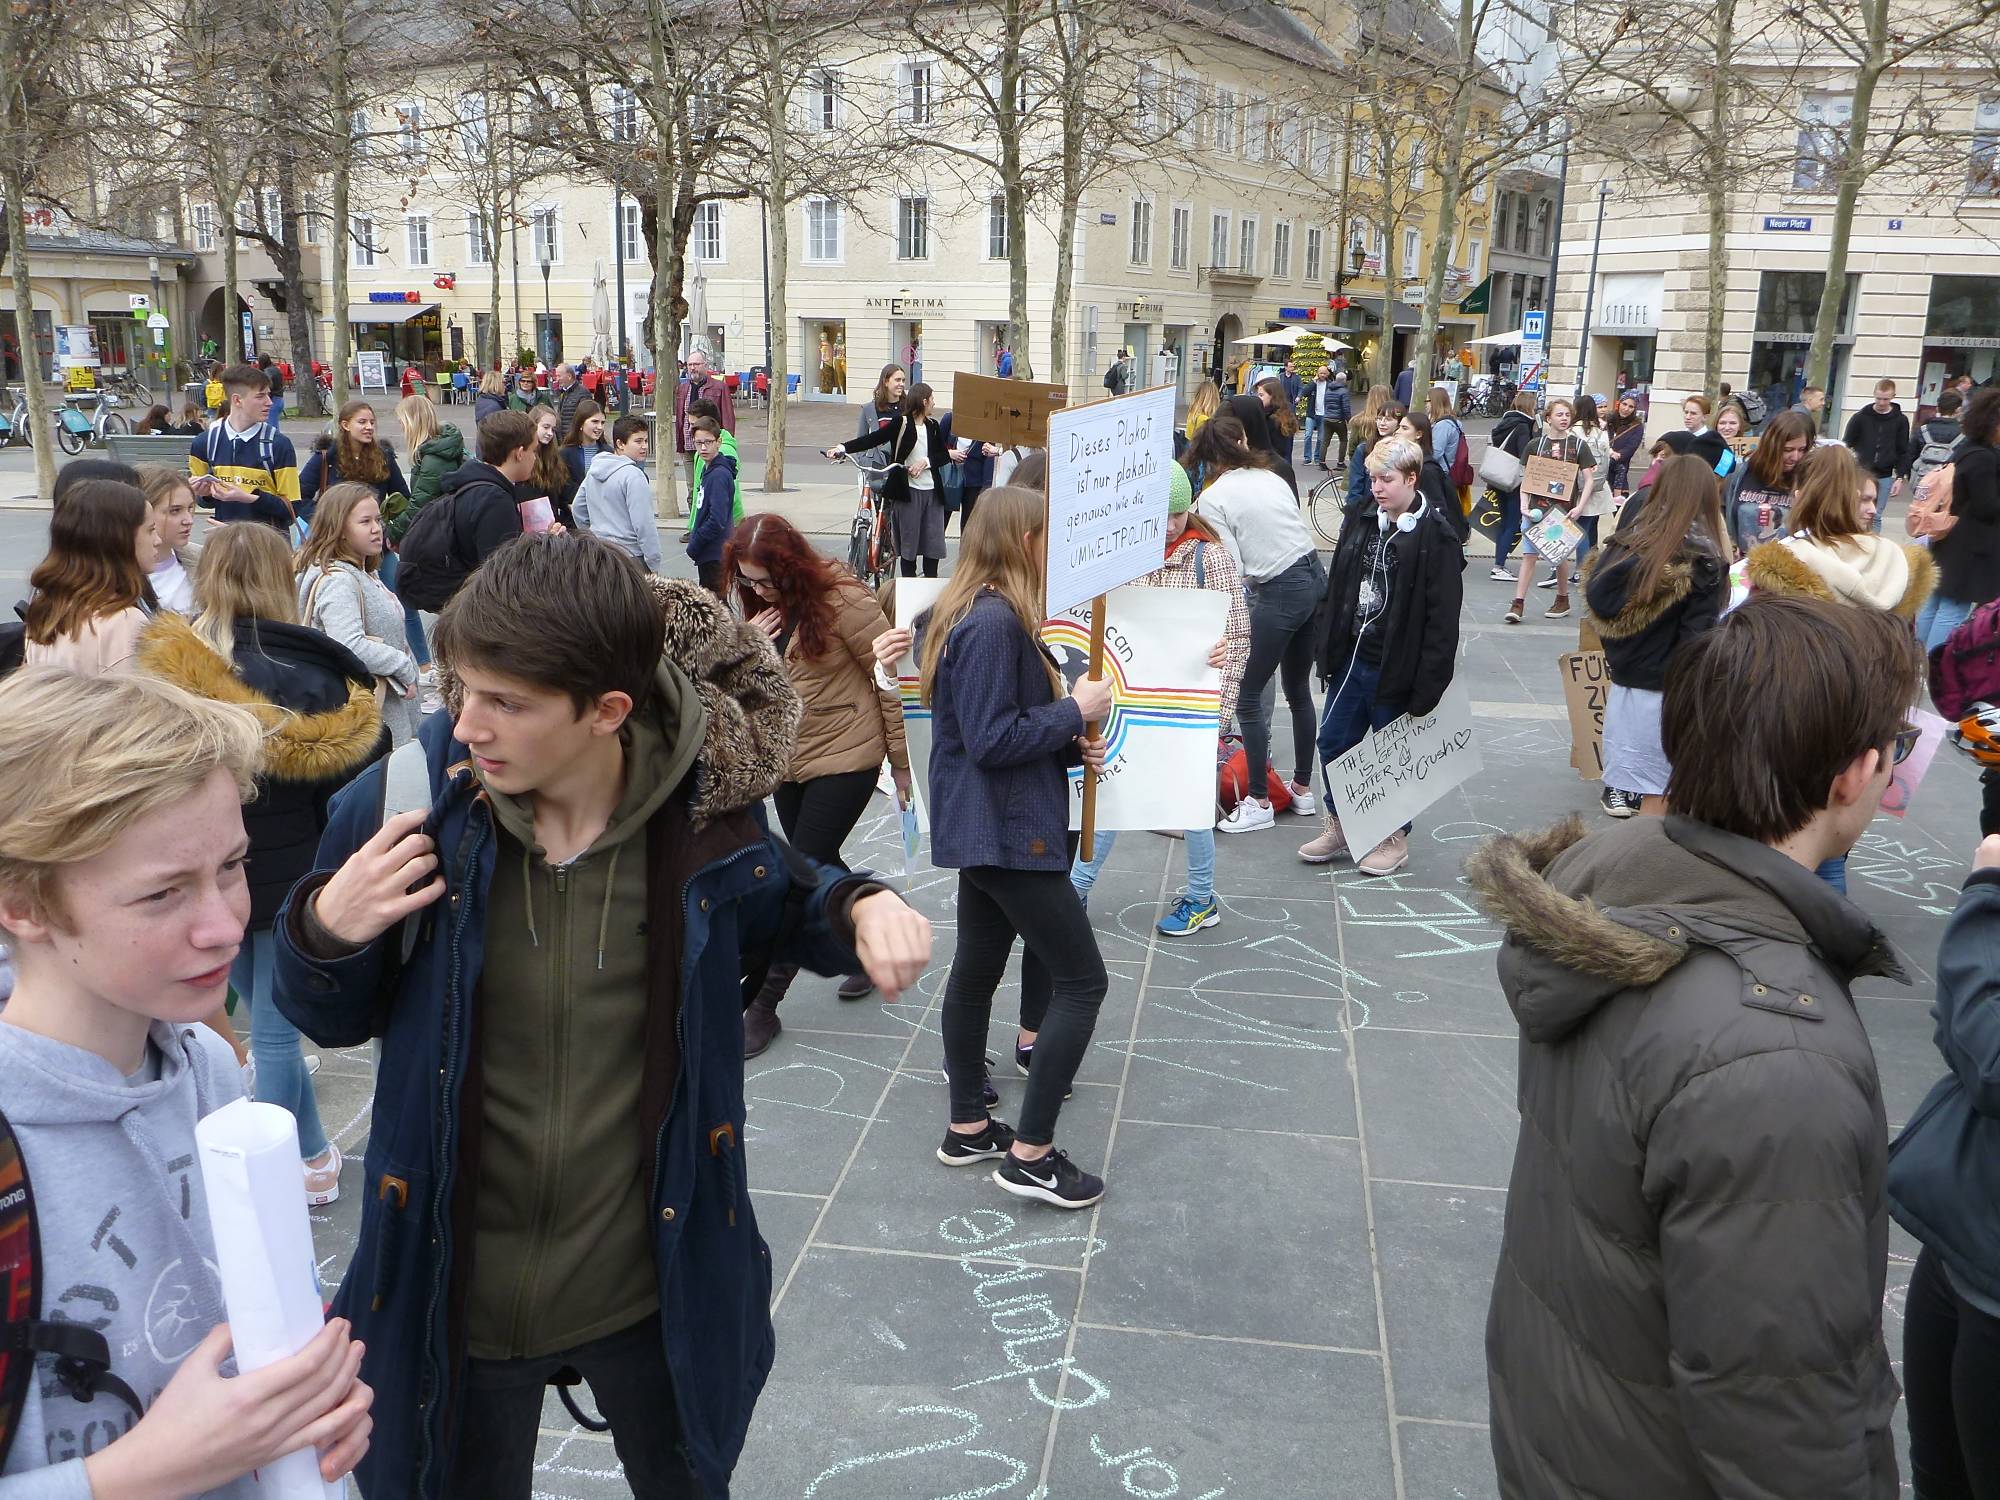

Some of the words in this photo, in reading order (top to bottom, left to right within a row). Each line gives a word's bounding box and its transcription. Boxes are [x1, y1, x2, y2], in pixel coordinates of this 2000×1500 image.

[1790, 219, 1807, 229] Platz
[1891, 220, 1898, 229] 5
[865, 298, 944, 315] ANTEPRIMA
[1117, 302, 1164, 320] ANTEPRIMA
[1604, 304, 1648, 325] STOFFE
[1070, 432, 1111, 464] Dieses
[1116, 413, 1154, 447] Plakat
[1077, 464, 1094, 495] ist
[1093, 477, 1111, 491] nur
[1114, 450, 1159, 493] plakativ
[1066, 503, 1112, 542] genauso
[1115, 496, 1130, 512] wie
[1132, 490, 1144, 506] die
[1070, 516, 1160, 568] UMWELTPOLITIK
[1068, 606, 1092, 624] we
[1105, 625, 1136, 664] can
[1336, 749, 1367, 775] THE
[1372, 713, 1414, 756] EARTH
[1359, 762, 1374, 777] IS
[1378, 716, 1437, 764] GETTING
[1075, 752, 1128, 799] panet
[1345, 765, 1394, 804] HOTTER
[1355, 787, 1386, 815] THAN
[1394, 764, 1414, 787] MY
[1416, 738, 1454, 780] Crush
[939, 1207, 1110, 1409] change
